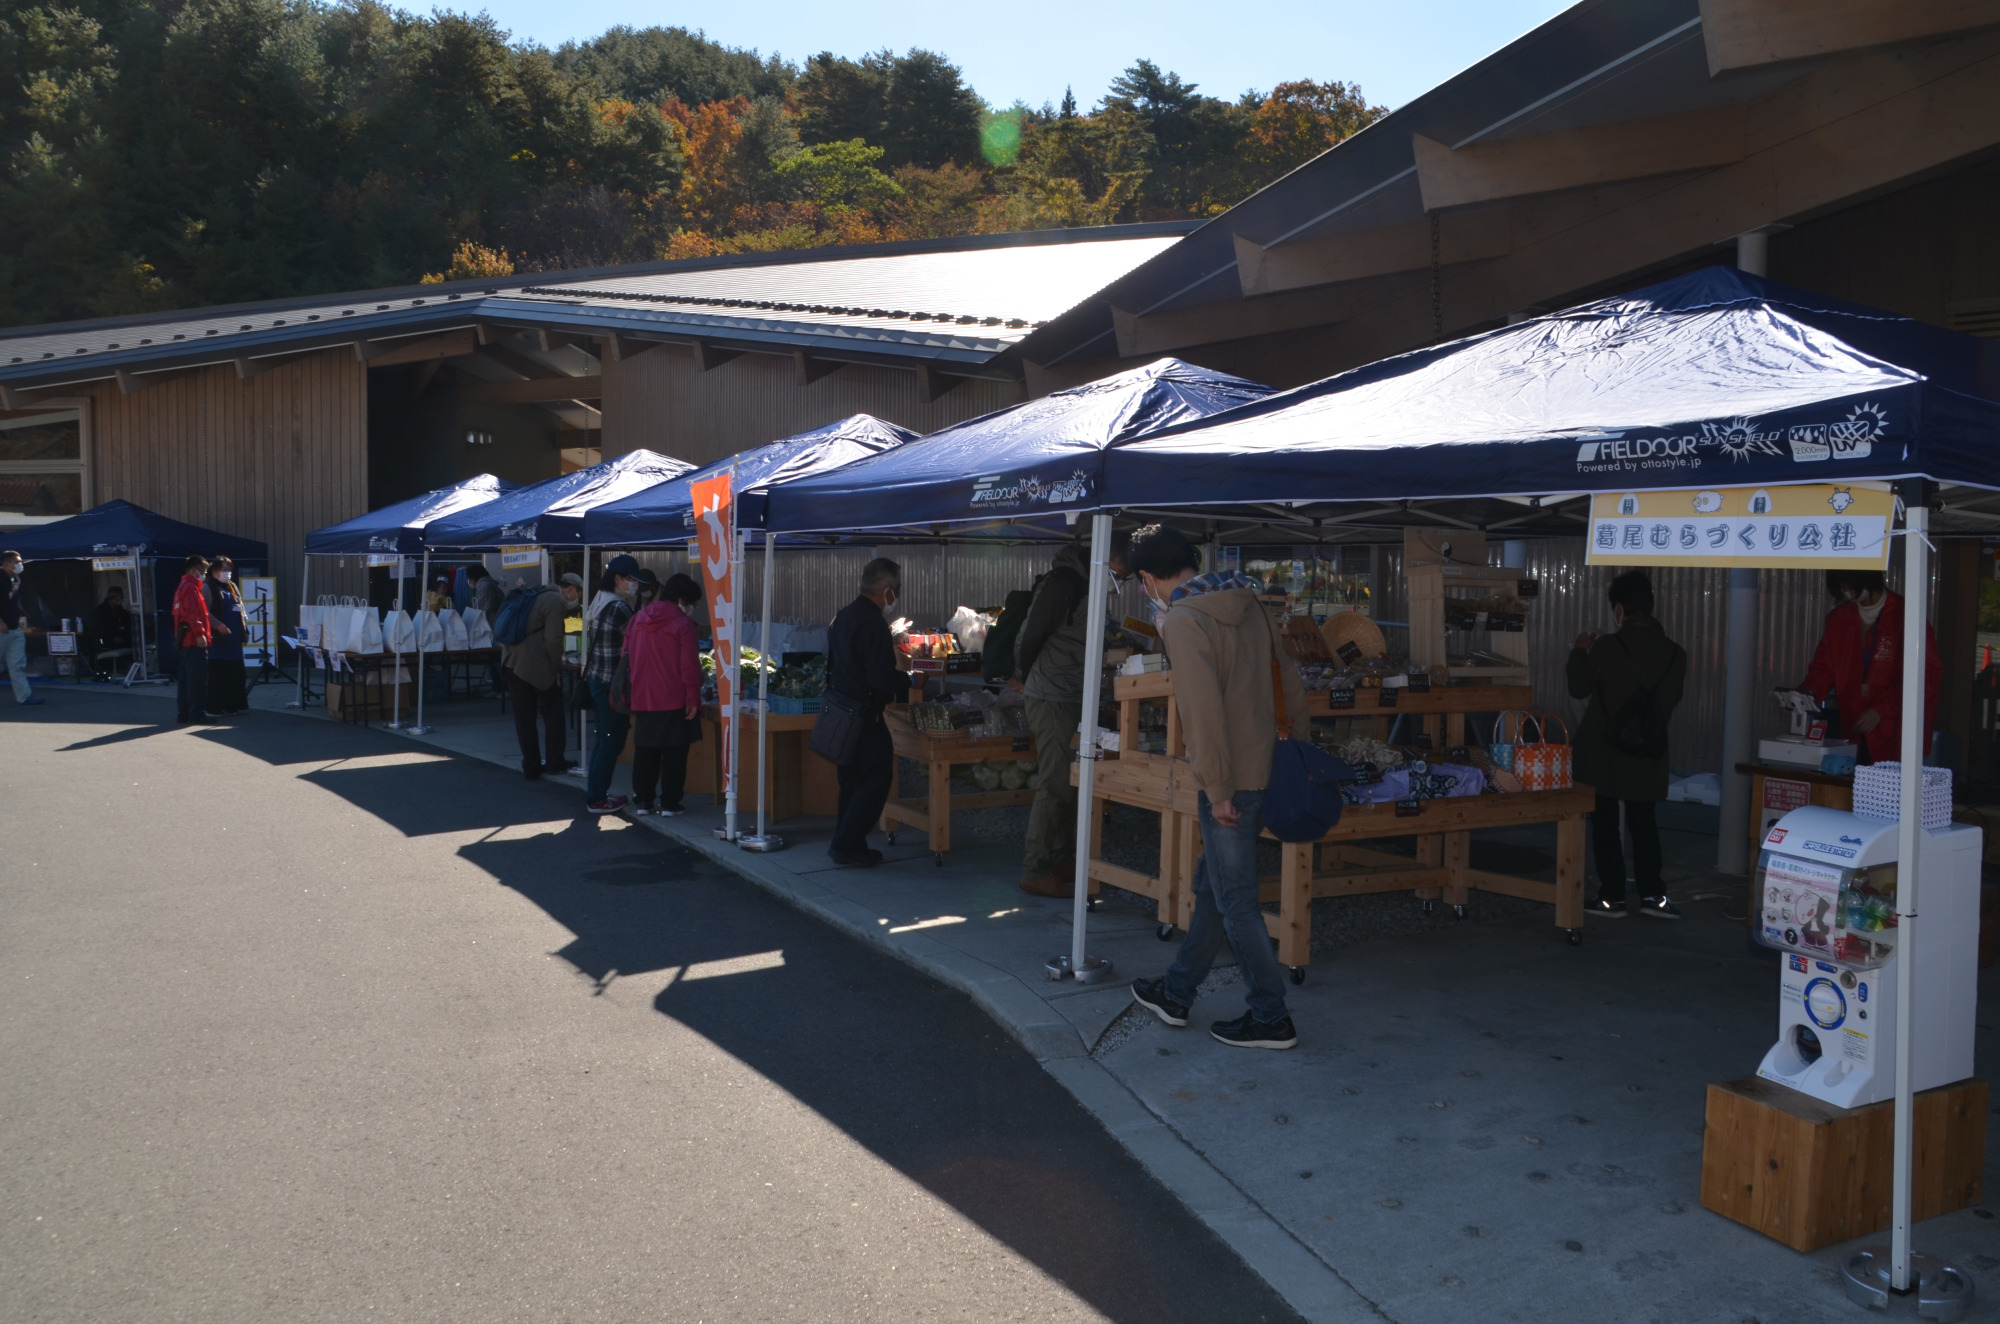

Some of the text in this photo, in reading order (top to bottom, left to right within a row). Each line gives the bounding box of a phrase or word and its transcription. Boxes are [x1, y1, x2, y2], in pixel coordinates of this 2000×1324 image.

[1600, 436, 1696, 460] FIELDOOR
[1833, 439, 1857, 452] UV
[1577, 457, 1702, 474] Powered by ottostyle.jp
[1596, 523, 1856, 551] 葛尾むらづくり公社
[249, 580, 268, 644] トイレ
